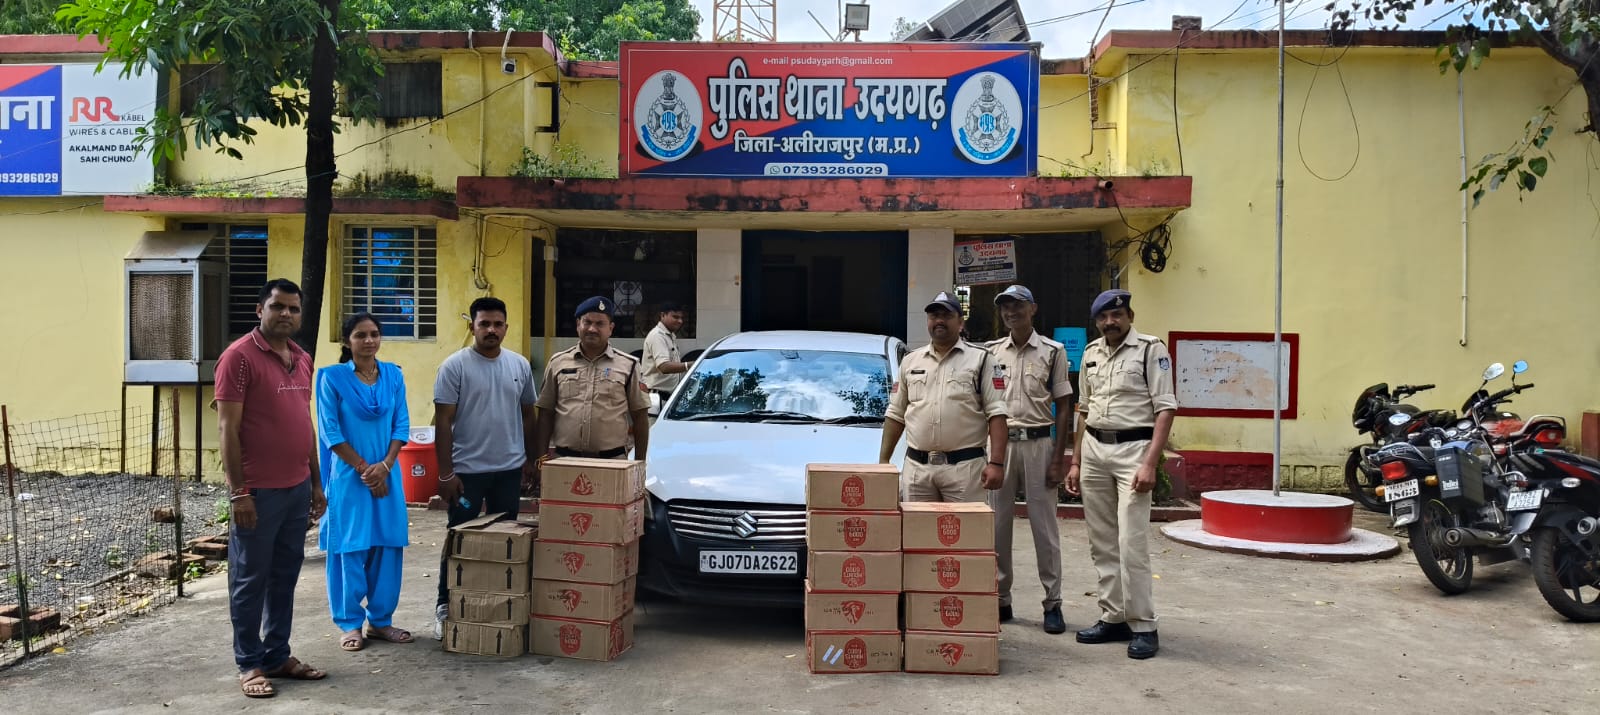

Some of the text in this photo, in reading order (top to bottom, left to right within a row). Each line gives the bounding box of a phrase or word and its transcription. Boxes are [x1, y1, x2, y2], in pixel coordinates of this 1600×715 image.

[763, 56, 893, 67] e-mail psudaygarh@gmail.com
[708, 57, 948, 139] पुलिस थाना उदयगढ़
[69, 97, 121, 122] RR
[69, 128, 99, 136] WIRES
[101, 128, 107, 136] &
[734, 130, 864, 160] जिला-अलीराजपुर
[782, 165, 883, 175] 07393286029
[0, 172, 59, 183] 93286029
[708, 554, 797, 571] GJ07DA2622
